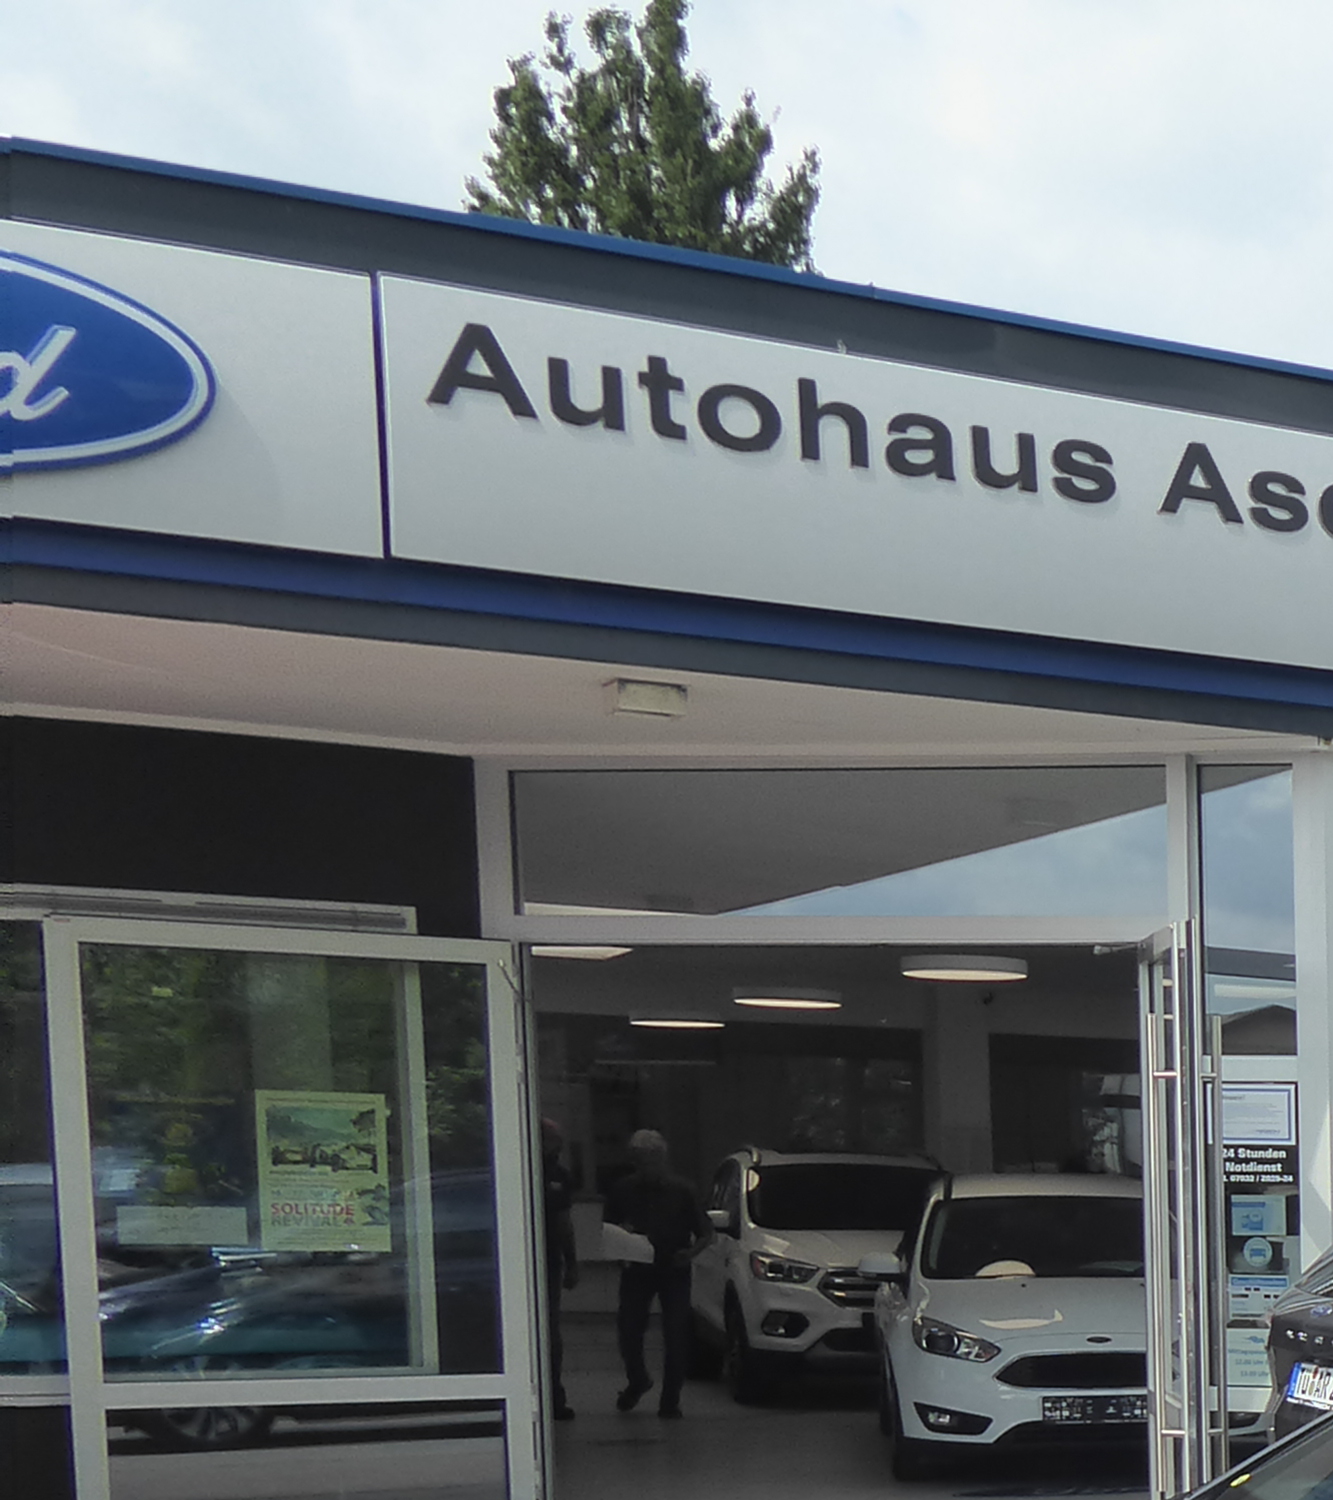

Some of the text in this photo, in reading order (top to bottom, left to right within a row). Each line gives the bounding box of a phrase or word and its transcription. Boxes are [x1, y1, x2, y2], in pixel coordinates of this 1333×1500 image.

[426, 322, 1117, 504] Autohaus
[1237, 1148, 1287, 1158] Stunden
[1225, 1161, 1283, 1172] Notdienst
[271, 1202, 355, 1217] SOLITUDE
